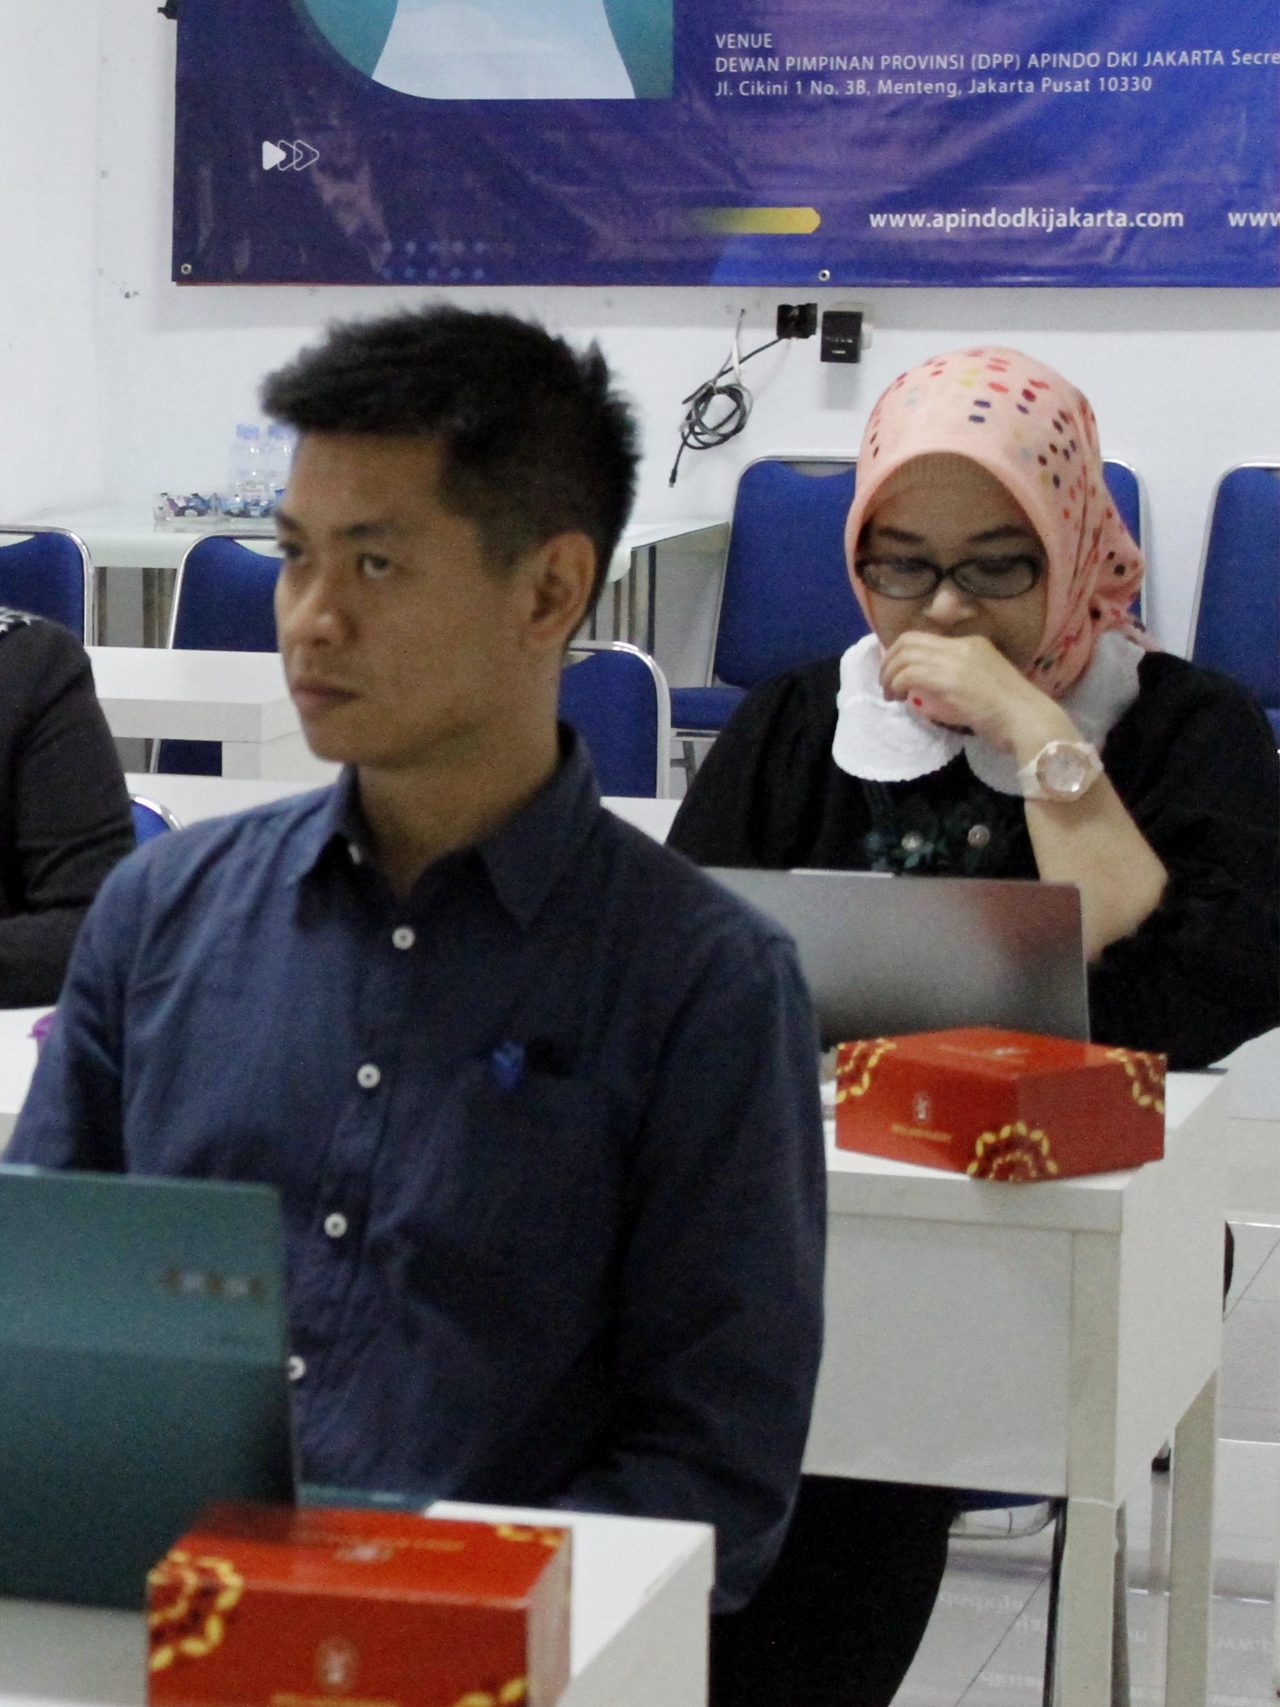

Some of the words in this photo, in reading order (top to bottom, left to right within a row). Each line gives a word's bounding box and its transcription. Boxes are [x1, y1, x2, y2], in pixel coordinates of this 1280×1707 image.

[714, 33, 773, 49] VENUE
[715, 57, 779, 73] DEWAN
[785, 55, 875, 72] PIMPINAN
[880, 54, 965, 71] PROVINSI
[970, 53, 1021, 71] (DPP)
[1027, 52, 1101, 69] APINDO
[1106, 52, 1138, 68] DKI
[1143, 50, 1225, 67] JAKARTA
[714, 81, 733, 96] Jl.
[739, 80, 789, 96] Cikini
[795, 80, 803, 95] 1
[810, 80, 839, 96] No.
[846, 80, 871, 97] 3B,
[877, 78, 962, 98] Menteng,
[967, 77, 1035, 94] Jakarta
[1041, 76, 1091, 92] Pusat
[1099, 76, 1153, 92] 10330
[869, 207, 1184, 233] www.apindodkijakarta.com
